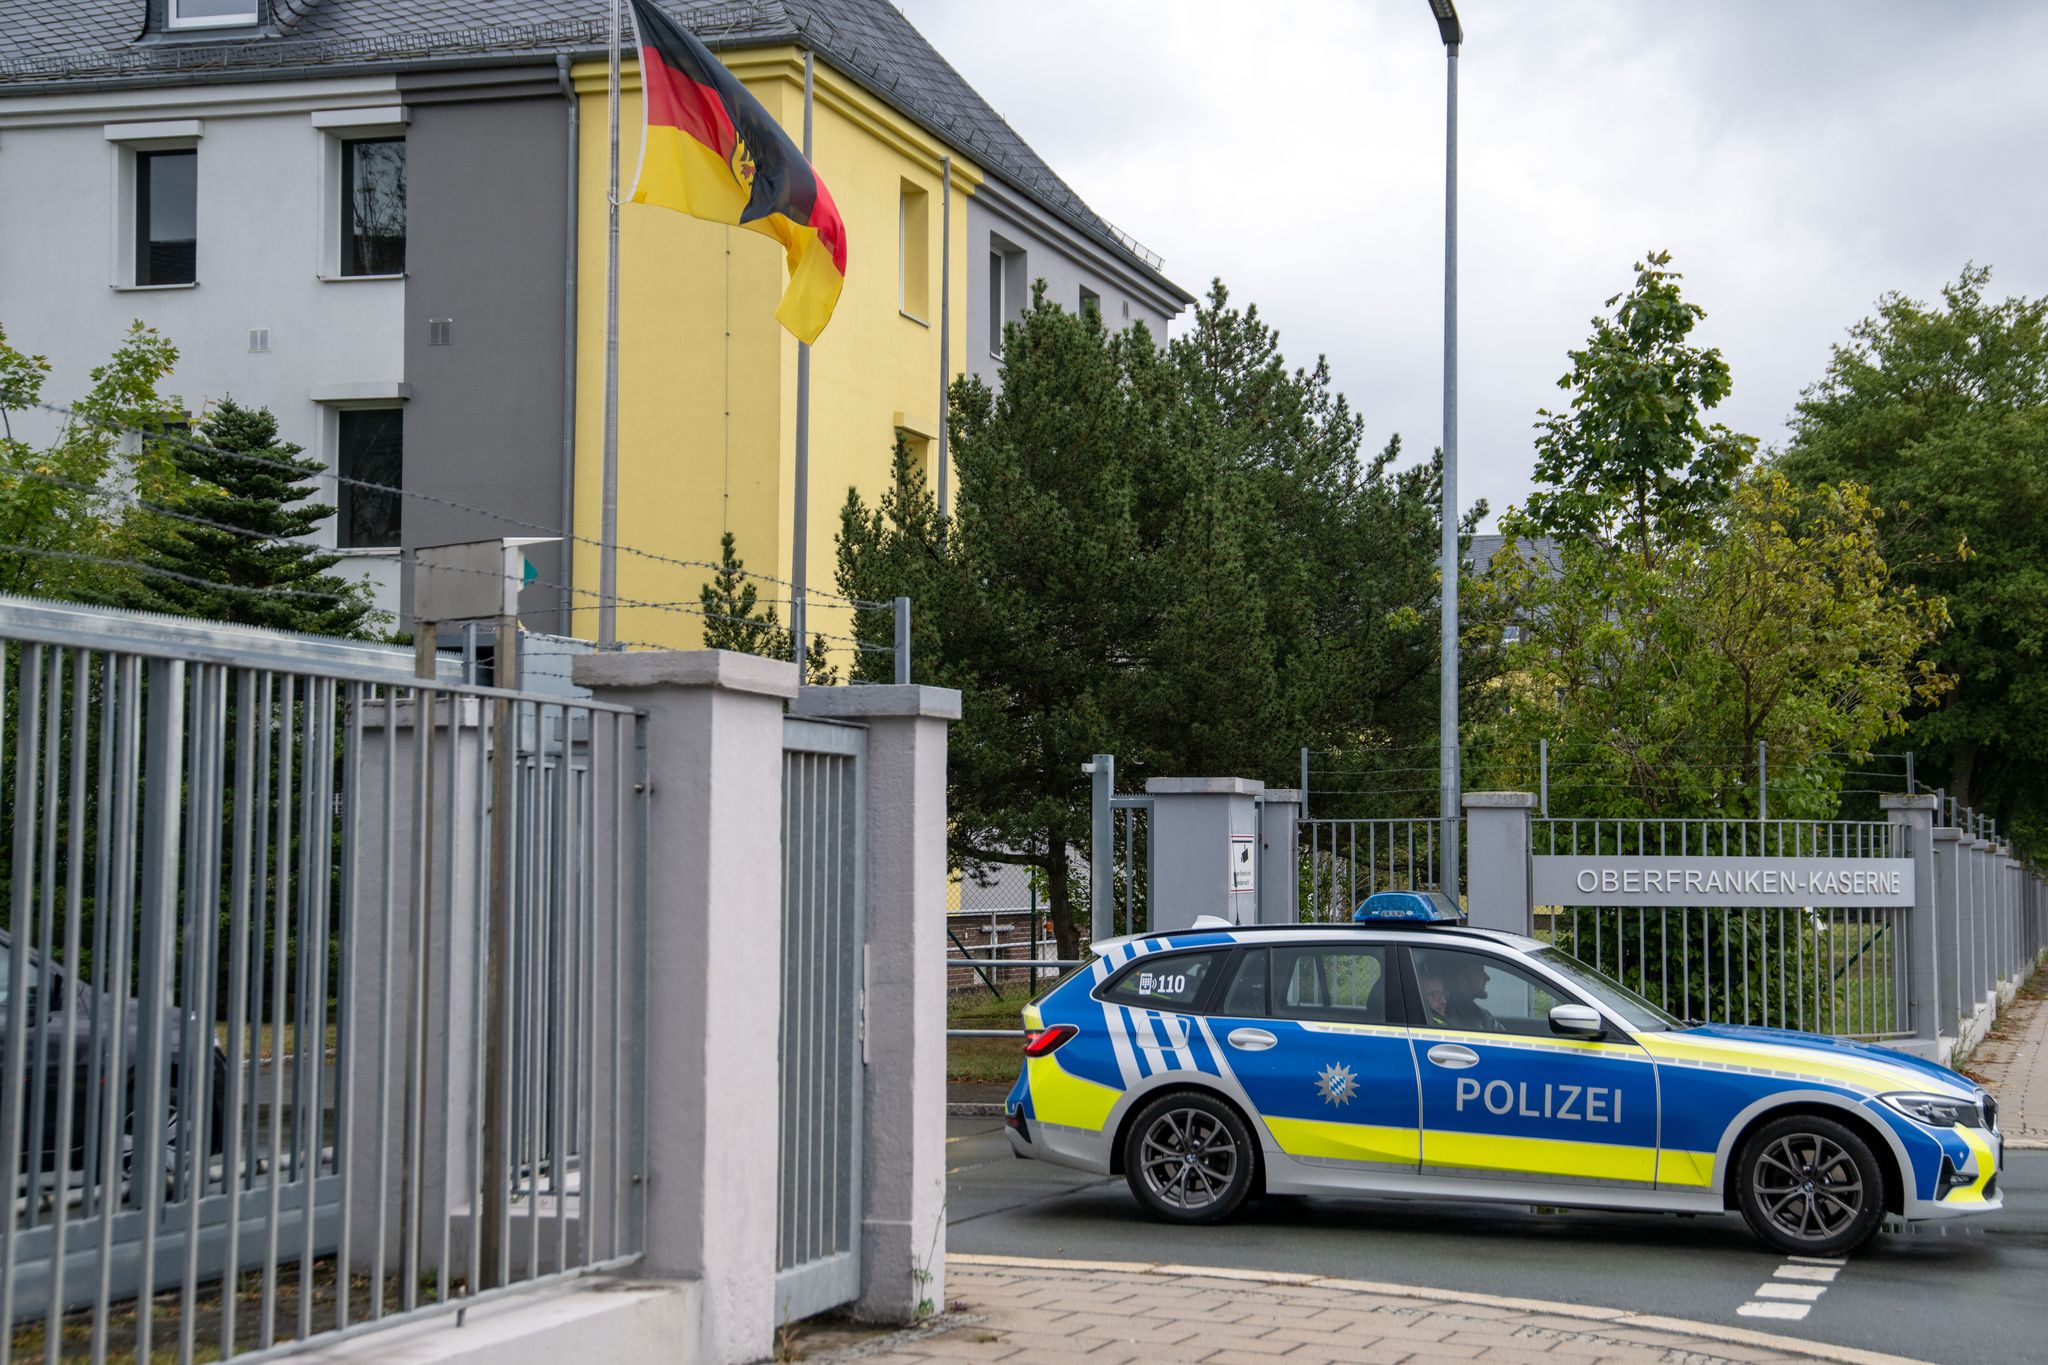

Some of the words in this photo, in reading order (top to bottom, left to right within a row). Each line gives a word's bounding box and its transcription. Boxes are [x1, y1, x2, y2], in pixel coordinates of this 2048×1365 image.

[1576, 869, 1900, 894] OBERFRANKEN-KASERNE
[1157, 974, 1185, 993] 110
[1456, 1077, 1622, 1124] POLIZEI
